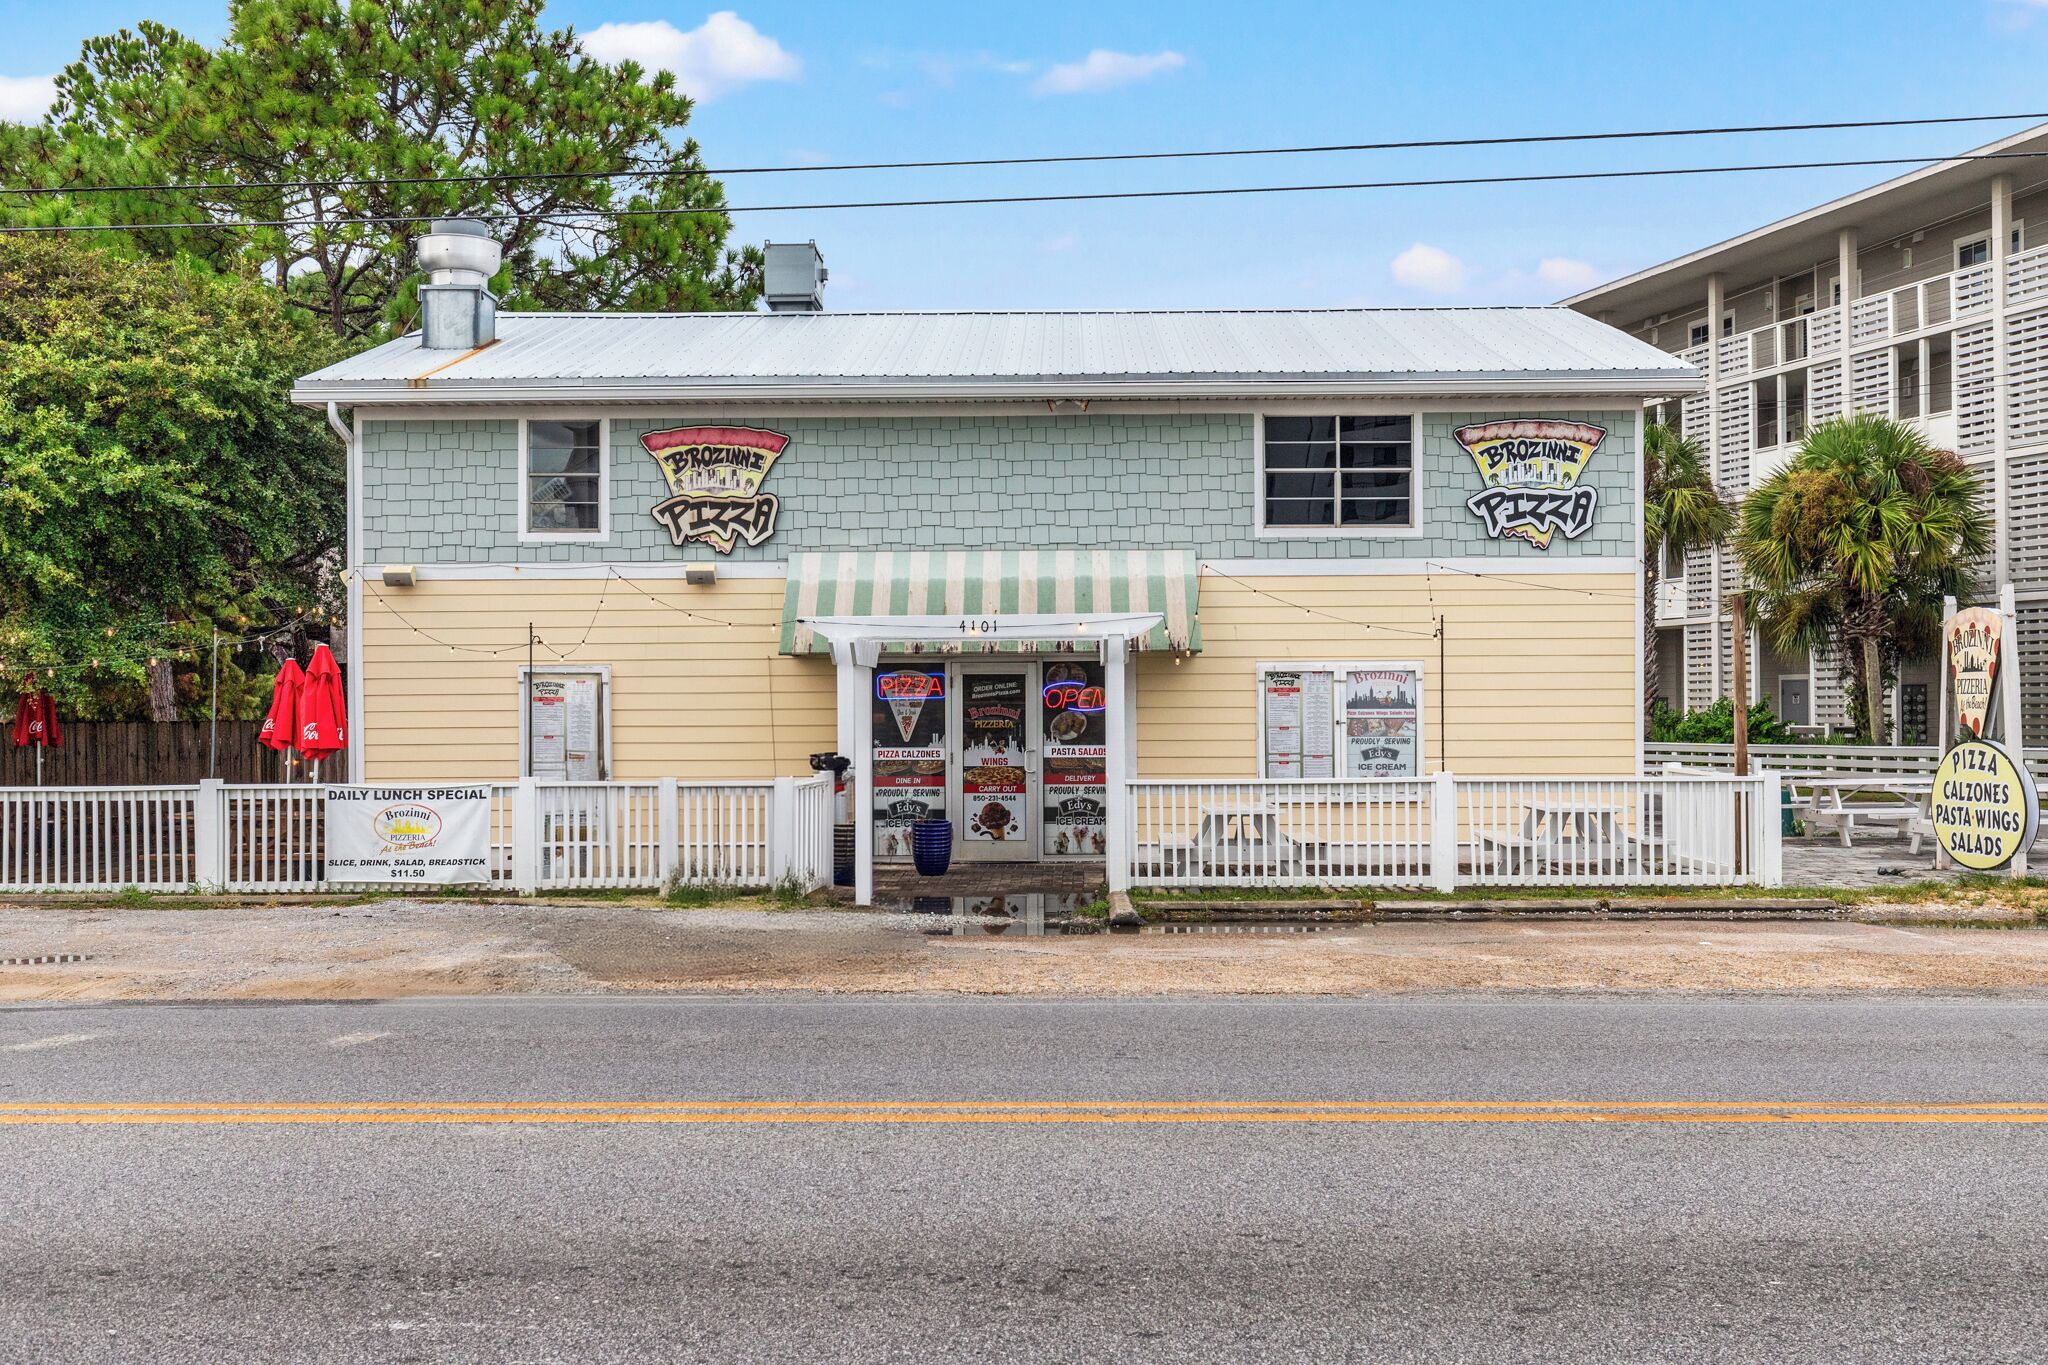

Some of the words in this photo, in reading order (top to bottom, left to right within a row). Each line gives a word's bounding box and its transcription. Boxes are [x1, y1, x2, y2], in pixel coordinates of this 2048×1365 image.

[663, 445, 768, 477] BROZINNI
[1478, 439, 1583, 471] BROZINNI
[1472, 490, 1593, 534] PIZZA
[657, 498, 775, 540] PIZZA
[959, 620, 997, 633] 4101
[1952, 629, 1994, 658] BROZINNI
[1353, 672, 1409, 684] Brozinni
[880, 677, 943, 697] PIZZA
[973, 685, 993, 693] ORDER
[1956, 678, 1988, 695] PIZZERIA
[1046, 688, 1106, 709] OPEN
[968, 703, 1022, 720] Brozinni
[974, 719, 1015, 729] PIZZERIA
[1350, 737, 1380, 745] PROUDLY
[1384, 737, 1411, 745] SERVING
[877, 750, 900, 758] PIZZA
[901, 750, 941, 758] CALZONES
[1051, 747, 1076, 756] PASTA
[1368, 749, 1393, 758] Edy's
[981, 757, 1009, 766] WINGS
[1358, 763, 1372, 771] ICE
[1375, 763, 1407, 771] CREAM
[1952, 748, 1997, 776] PIZZA
[328, 790, 369, 801] DAILY
[373, 790, 423, 801] LUNCH
[427, 789, 487, 801] SPECIAL
[878, 788, 909, 797] PROUDLY
[912, 788, 941, 797] SERVING
[1049, 786, 1080, 795] PROUDLY
[1083, 786, 1106, 795] SERVIN
[1943, 780, 2009, 805] CALZONES
[896, 801, 922, 813] Edy's
[1067, 800, 1092, 811] Edy's
[384, 808, 432, 821] Brozinni
[1936, 804, 1972, 827] PASTA
[1975, 808, 2020, 833] WINGS
[885, 820, 901, 828] ICE
[1056, 817, 1072, 826] ICE
[1074, 817, 1106, 826] CREAM
[1951, 832, 2002, 857] SALADS
[328, 859, 357, 867] SLICE,
[360, 859, 391, 867] DRINK,
[393, 858, 426, 867] SALAD,
[428, 858, 486, 866] BREADSTICK
[390, 869, 425, 878] $11.50
